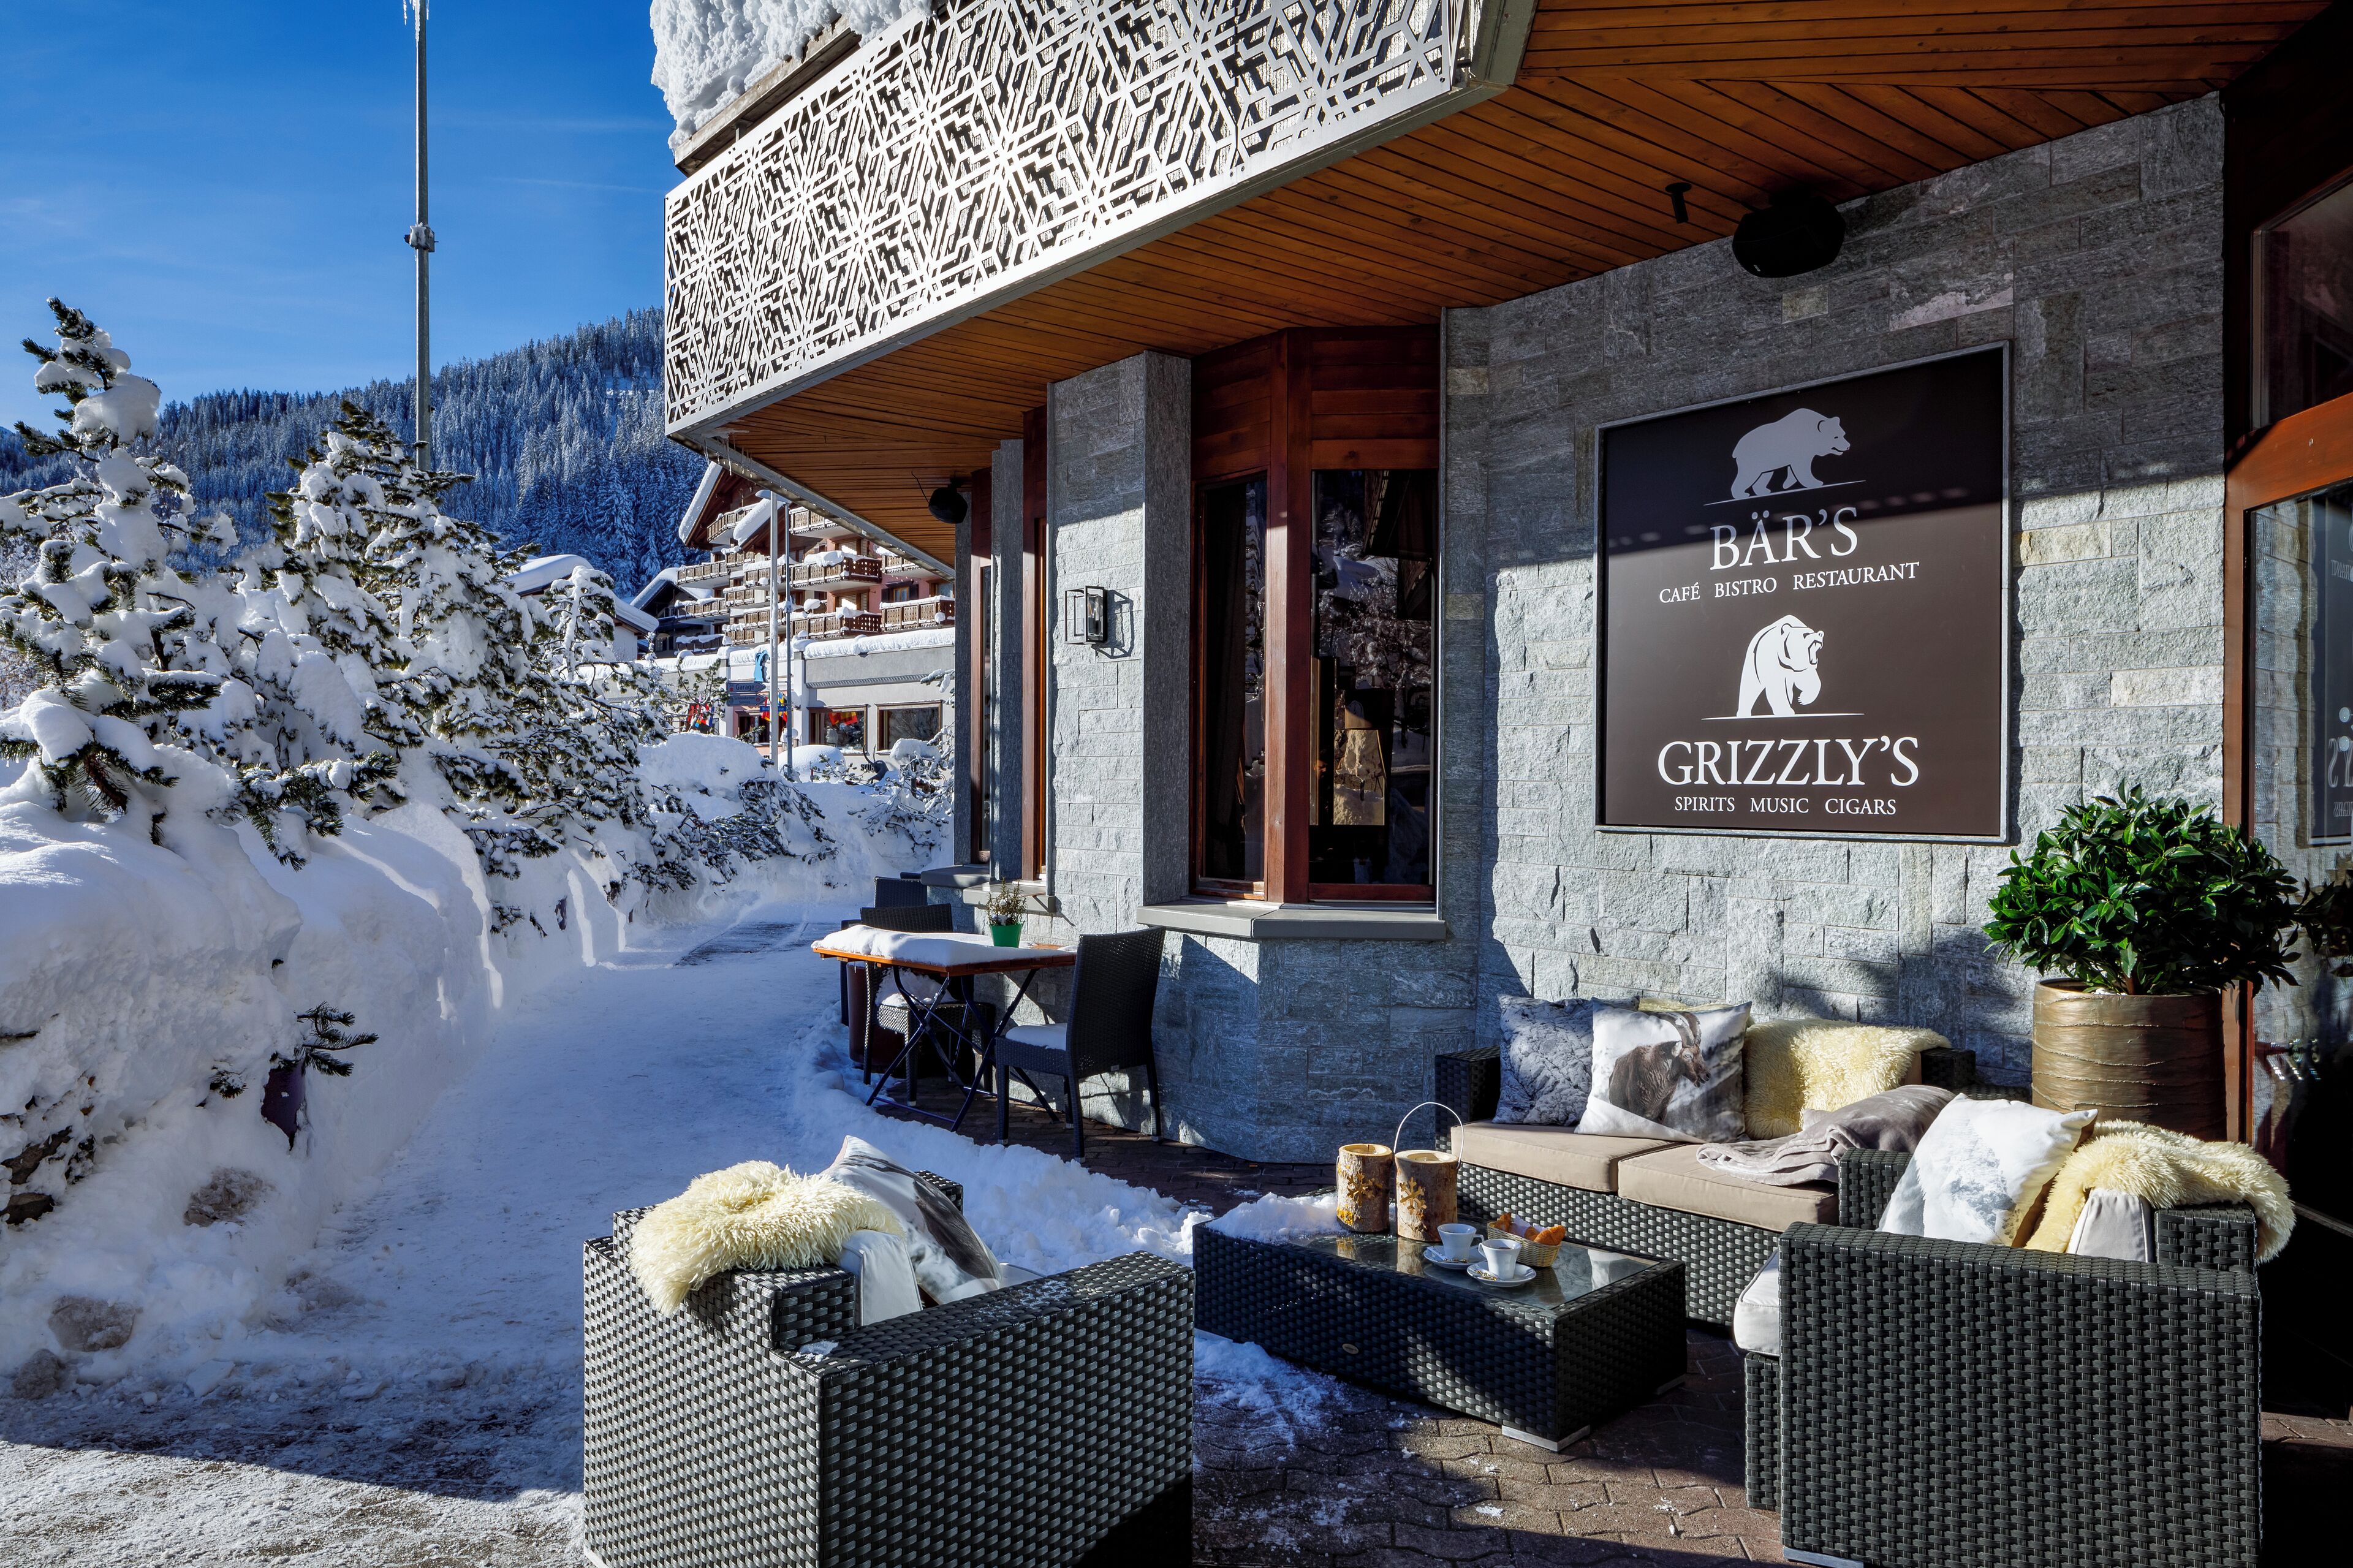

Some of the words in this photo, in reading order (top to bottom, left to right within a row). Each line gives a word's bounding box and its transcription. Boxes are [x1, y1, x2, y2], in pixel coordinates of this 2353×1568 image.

[1659, 581, 1700, 604] CAFÉ
[1714, 577, 1778, 599] BISTRO
[1793, 561, 1920, 590] RESTAURANT
[1658, 735, 1919, 787] GRIZZLY’S
[1675, 796, 1735, 812] SPIRITS
[1749, 797, 1809, 814] MUSIC
[1825, 798, 1896, 815] CIGARS
